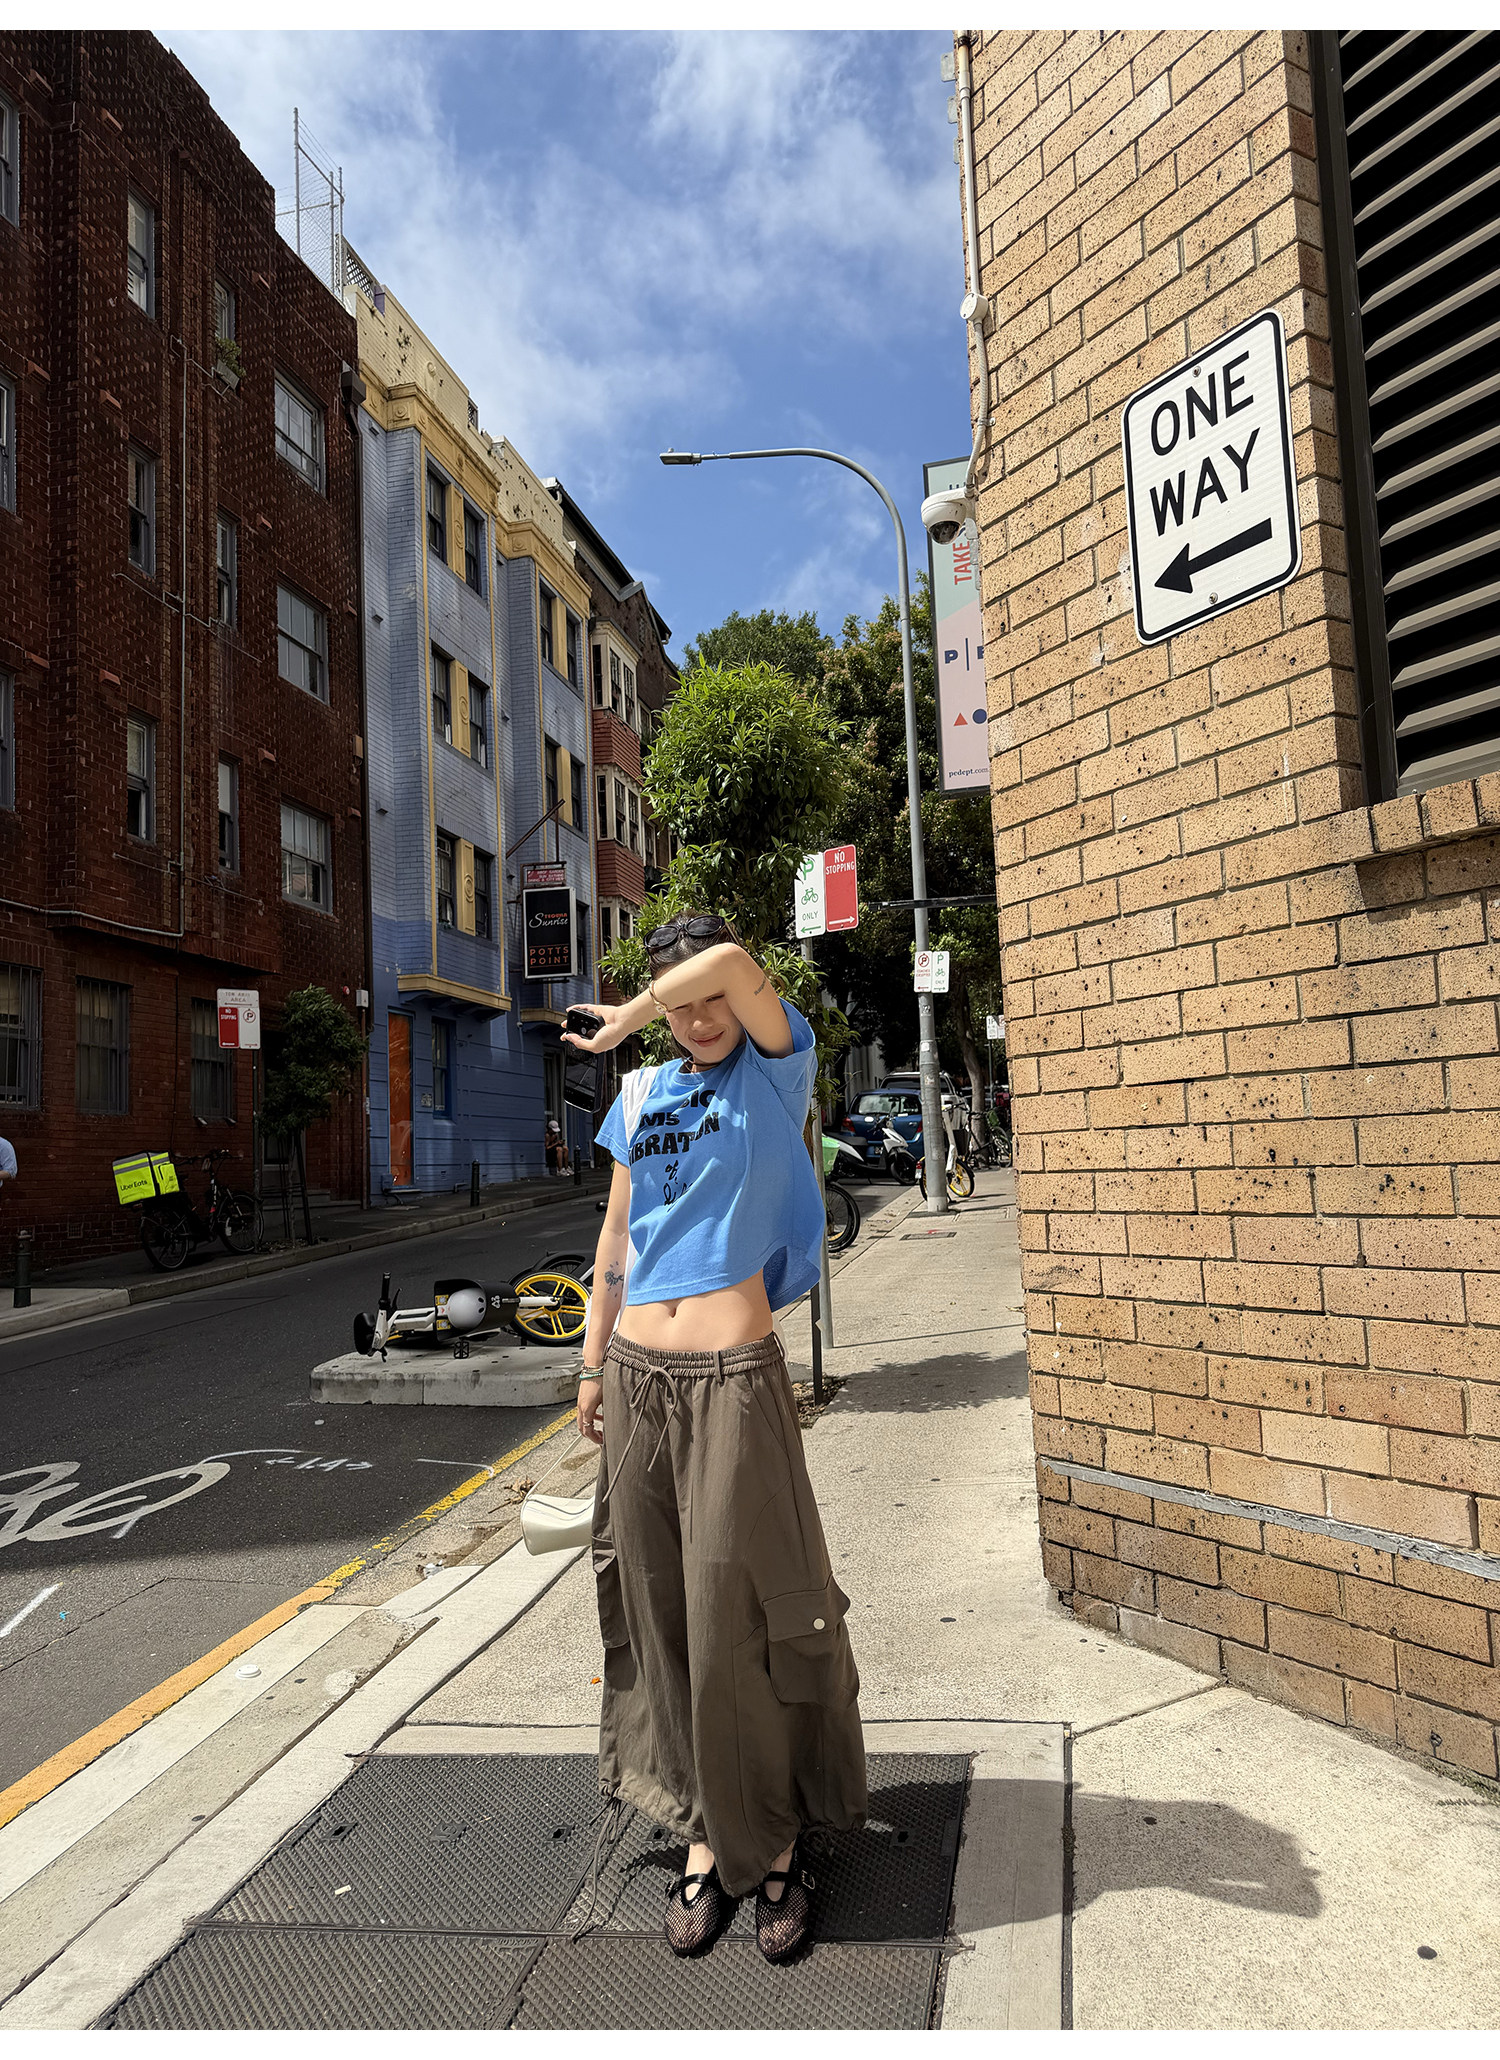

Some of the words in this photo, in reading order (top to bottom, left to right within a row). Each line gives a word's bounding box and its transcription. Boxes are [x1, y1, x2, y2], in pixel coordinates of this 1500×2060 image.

[1151, 350, 1254, 457] ONE
[1149, 427, 1261, 537] WAY
[953, 541, 972, 585] TAKE
[834, 851, 845, 863] NO
[825, 861, 855, 875] STOPPING
[529, 912, 568, 928] Sunrise
[802, 911, 818, 921] ONLY
[530, 946, 569, 956] POTTS
[530, 955, 569, 965] POINT
[665, 1160, 679, 1180] of
